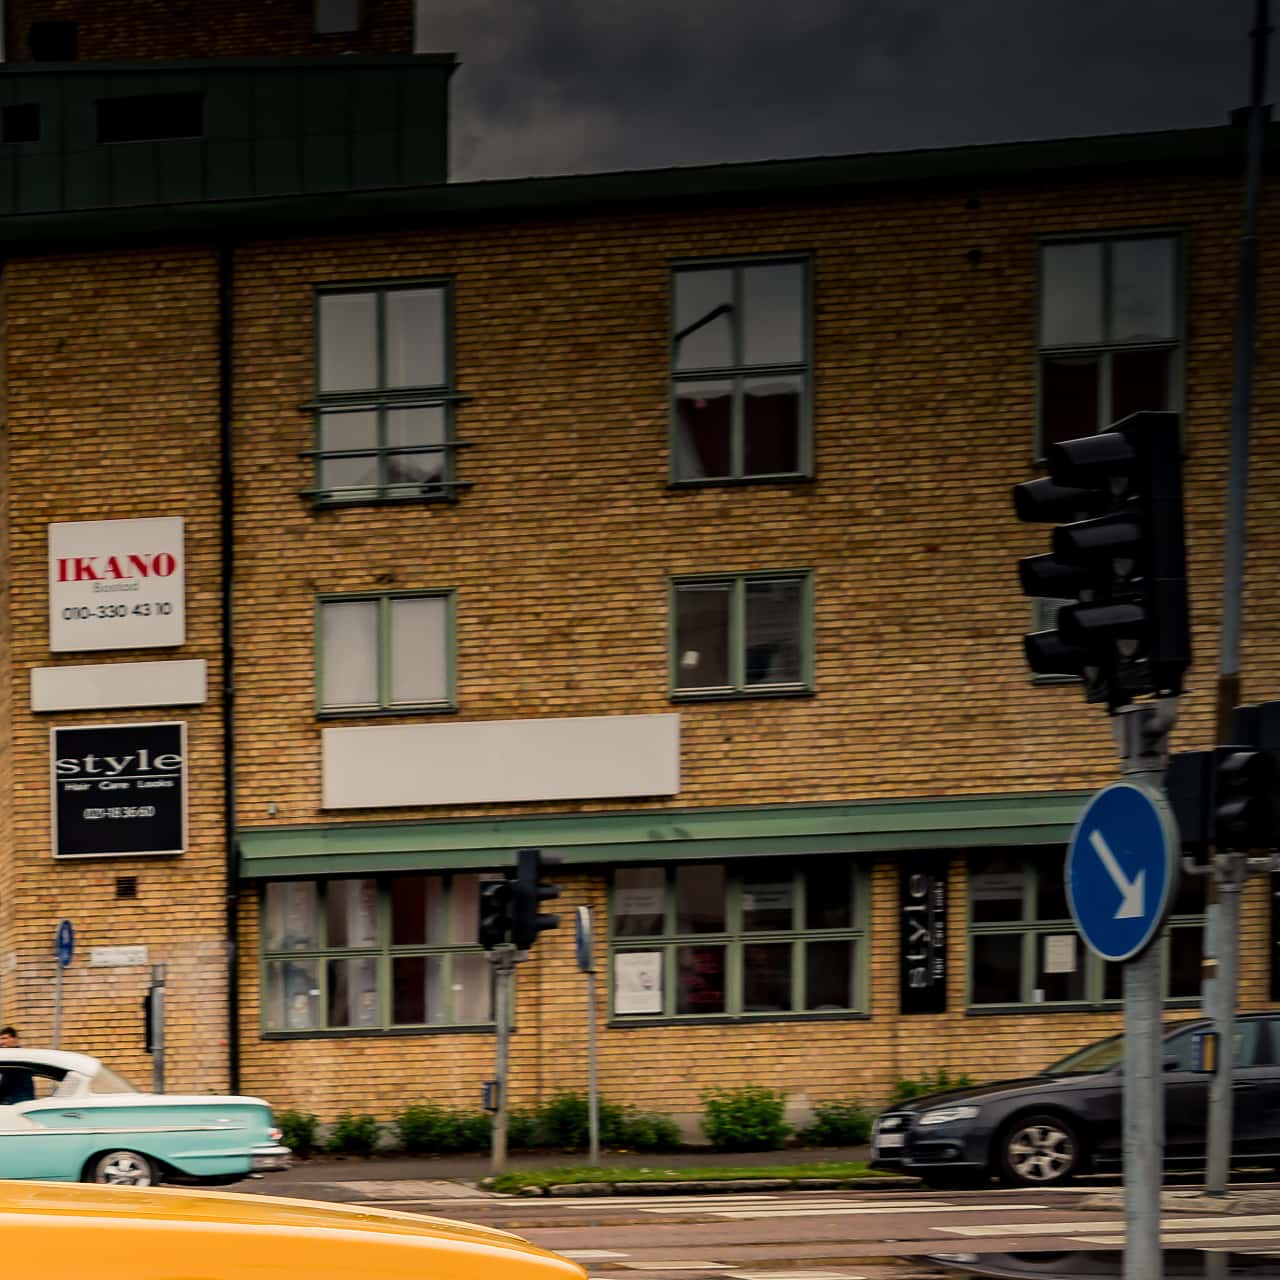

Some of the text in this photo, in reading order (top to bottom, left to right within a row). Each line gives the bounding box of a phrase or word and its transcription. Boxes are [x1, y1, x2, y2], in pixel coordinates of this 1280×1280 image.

[56, 552, 176, 582] IKANO
[62, 602, 173, 621] 010-330 43 10
[55, 749, 183, 775] style
[64, 779, 175, 791] Hair Care Looks
